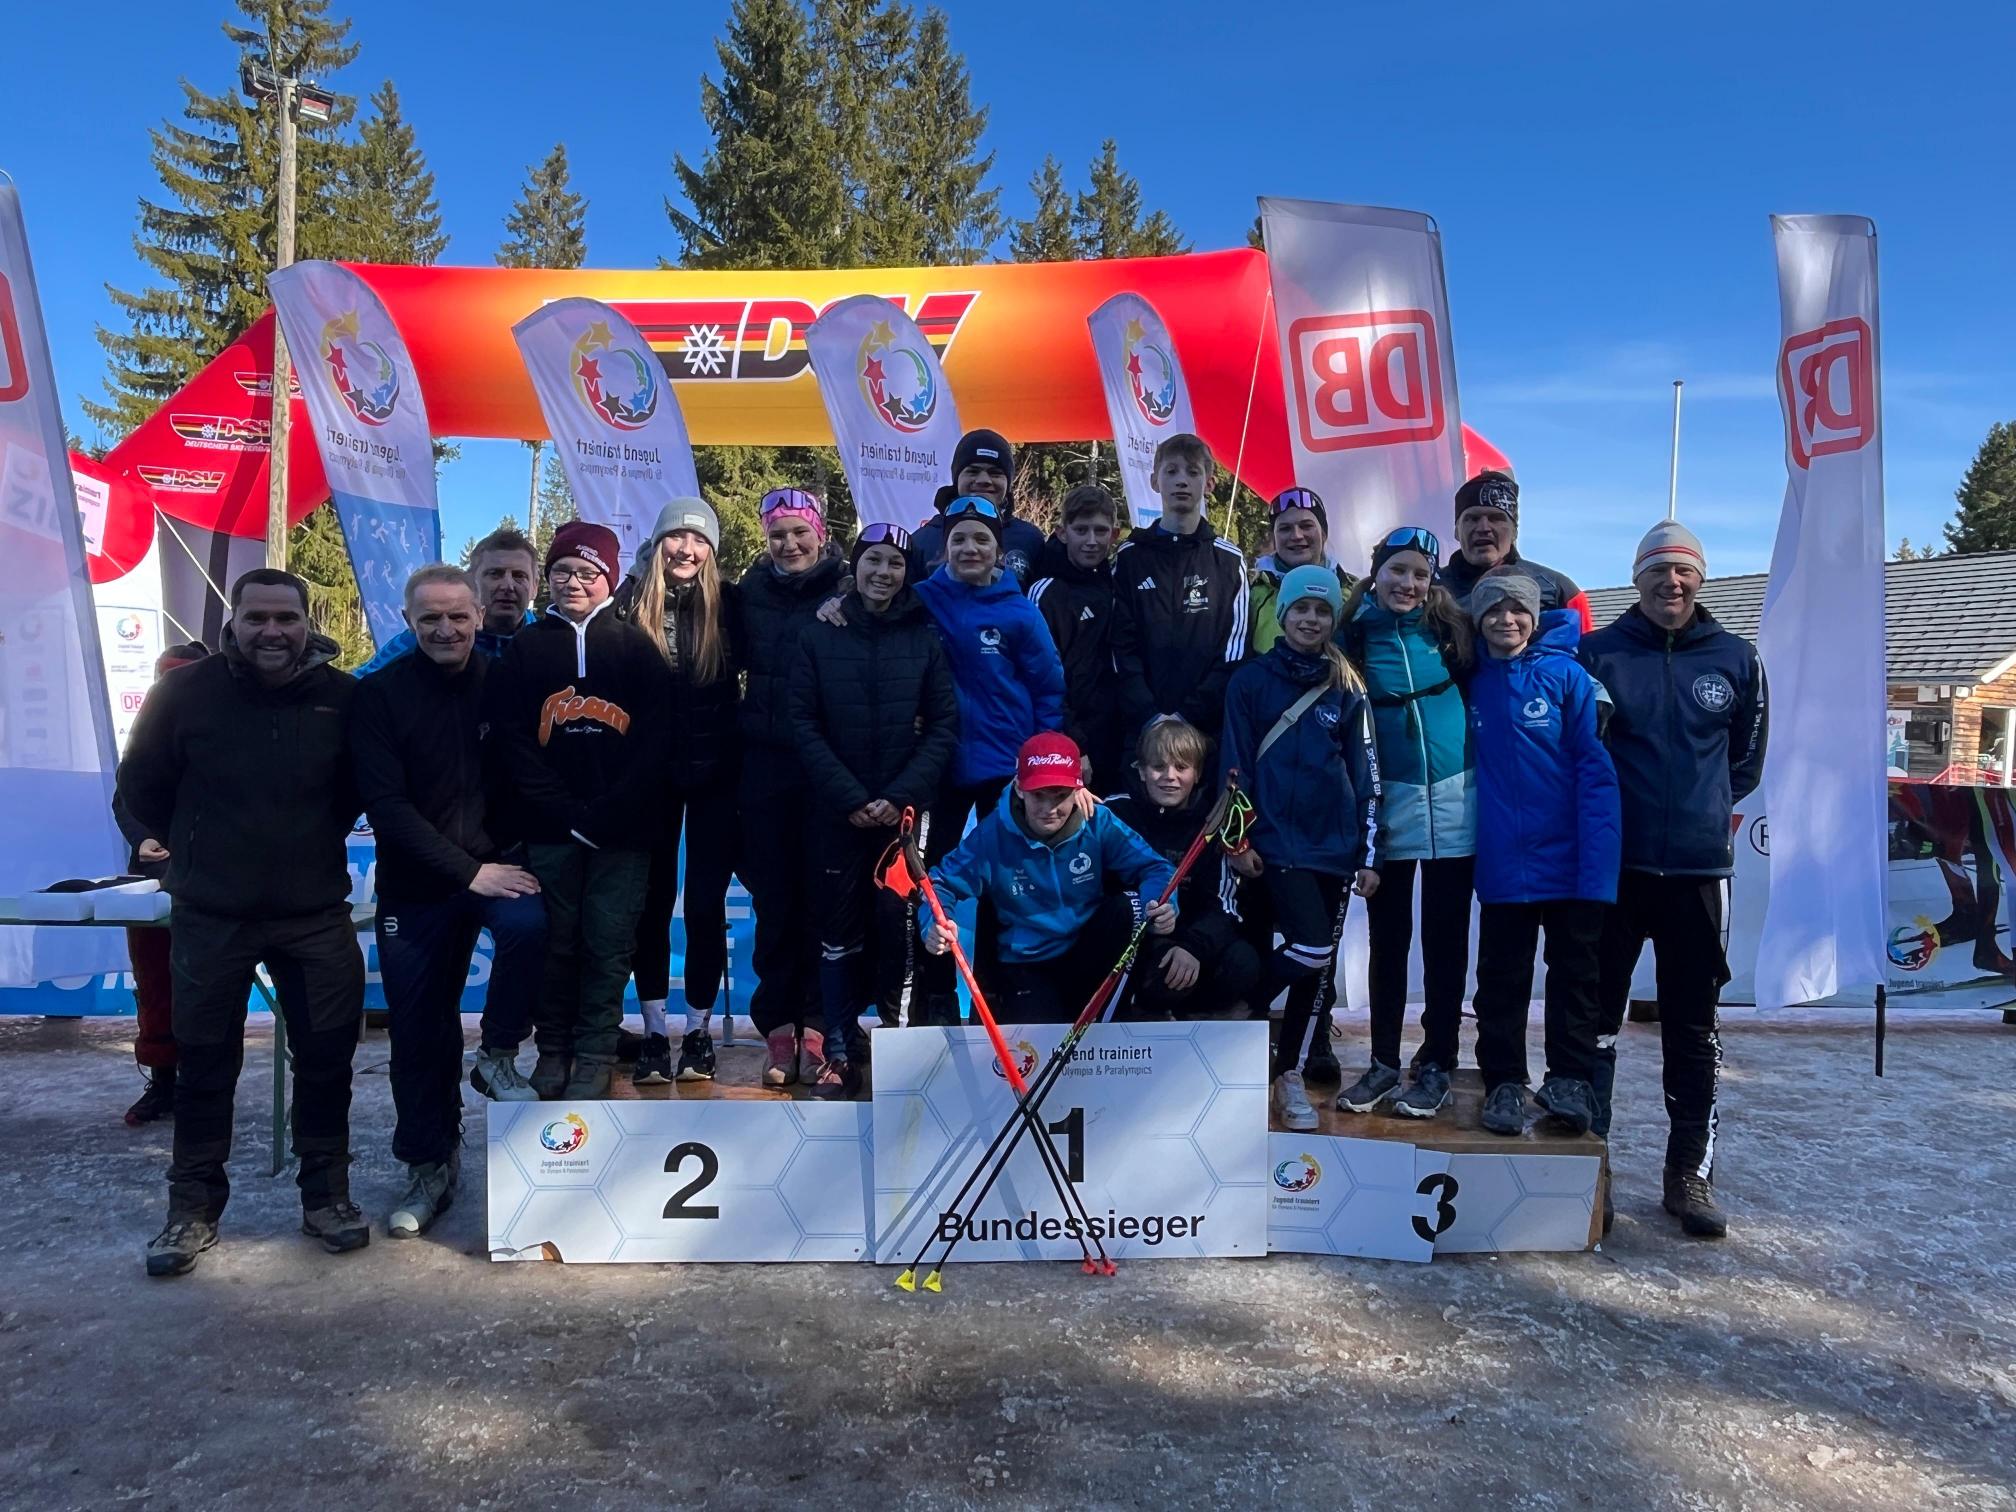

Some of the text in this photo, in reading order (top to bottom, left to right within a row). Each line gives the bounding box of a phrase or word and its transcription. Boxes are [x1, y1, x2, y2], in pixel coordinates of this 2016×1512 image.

[1095, 1065, 1102, 1076] &
[1104, 1064, 1153, 1077] Paralympics
[1099, 1045, 1153, 1061] trainiert
[1048, 1107, 1085, 1183] 1
[662, 1142, 720, 1219] 2
[938, 1209, 1206, 1247] Bundessieger
[1411, 1173, 1460, 1243] 3
